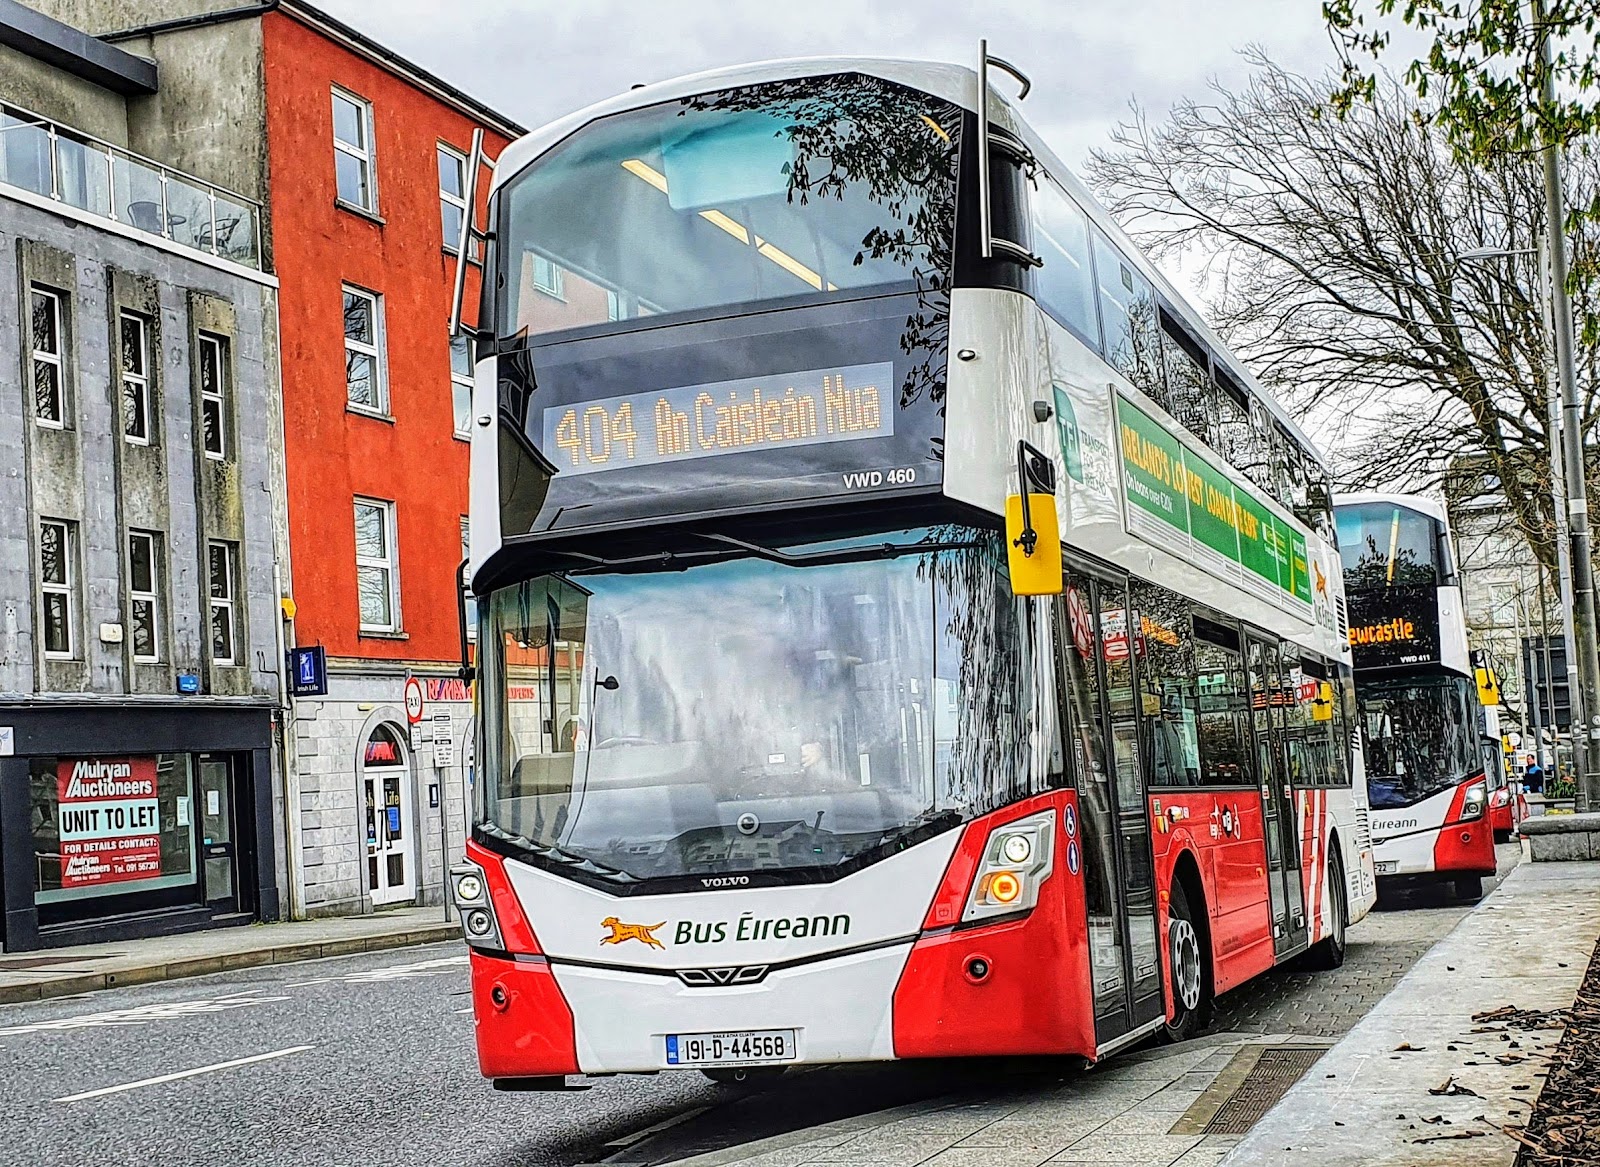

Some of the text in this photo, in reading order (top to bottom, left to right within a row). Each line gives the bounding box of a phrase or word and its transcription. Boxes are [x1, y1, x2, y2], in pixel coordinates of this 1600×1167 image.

[556, 374, 881, 466] 404 An Caisleán Nua
[1058, 416, 1079, 454] TFI
[1120, 422, 1170, 486] IRELAND'S
[843, 467, 916, 489] VWD 460
[1349, 618, 1414, 645] ewcastle
[1400, 654, 1431, 664] VWD 411
[426, 679, 464, 700] RE/MAX
[407, 697, 420, 708] TAXI
[72, 760, 131, 783] Mulryan
[67, 778, 153, 798] Auctioneers
[385, 791, 400, 806] Life
[62, 806, 155, 833] UNIT TO LET
[1372, 818, 1417, 830] Éireann
[64, 838, 157, 854] FOR DETAILS CONTACT:
[66, 864, 111, 876] Auctioneers
[126, 862, 137, 872] 091
[701, 876, 750, 889] VOLVO
[674, 911, 851, 945] Bus Éireann
[686, 1036, 784, 1060] 191-D-44568
